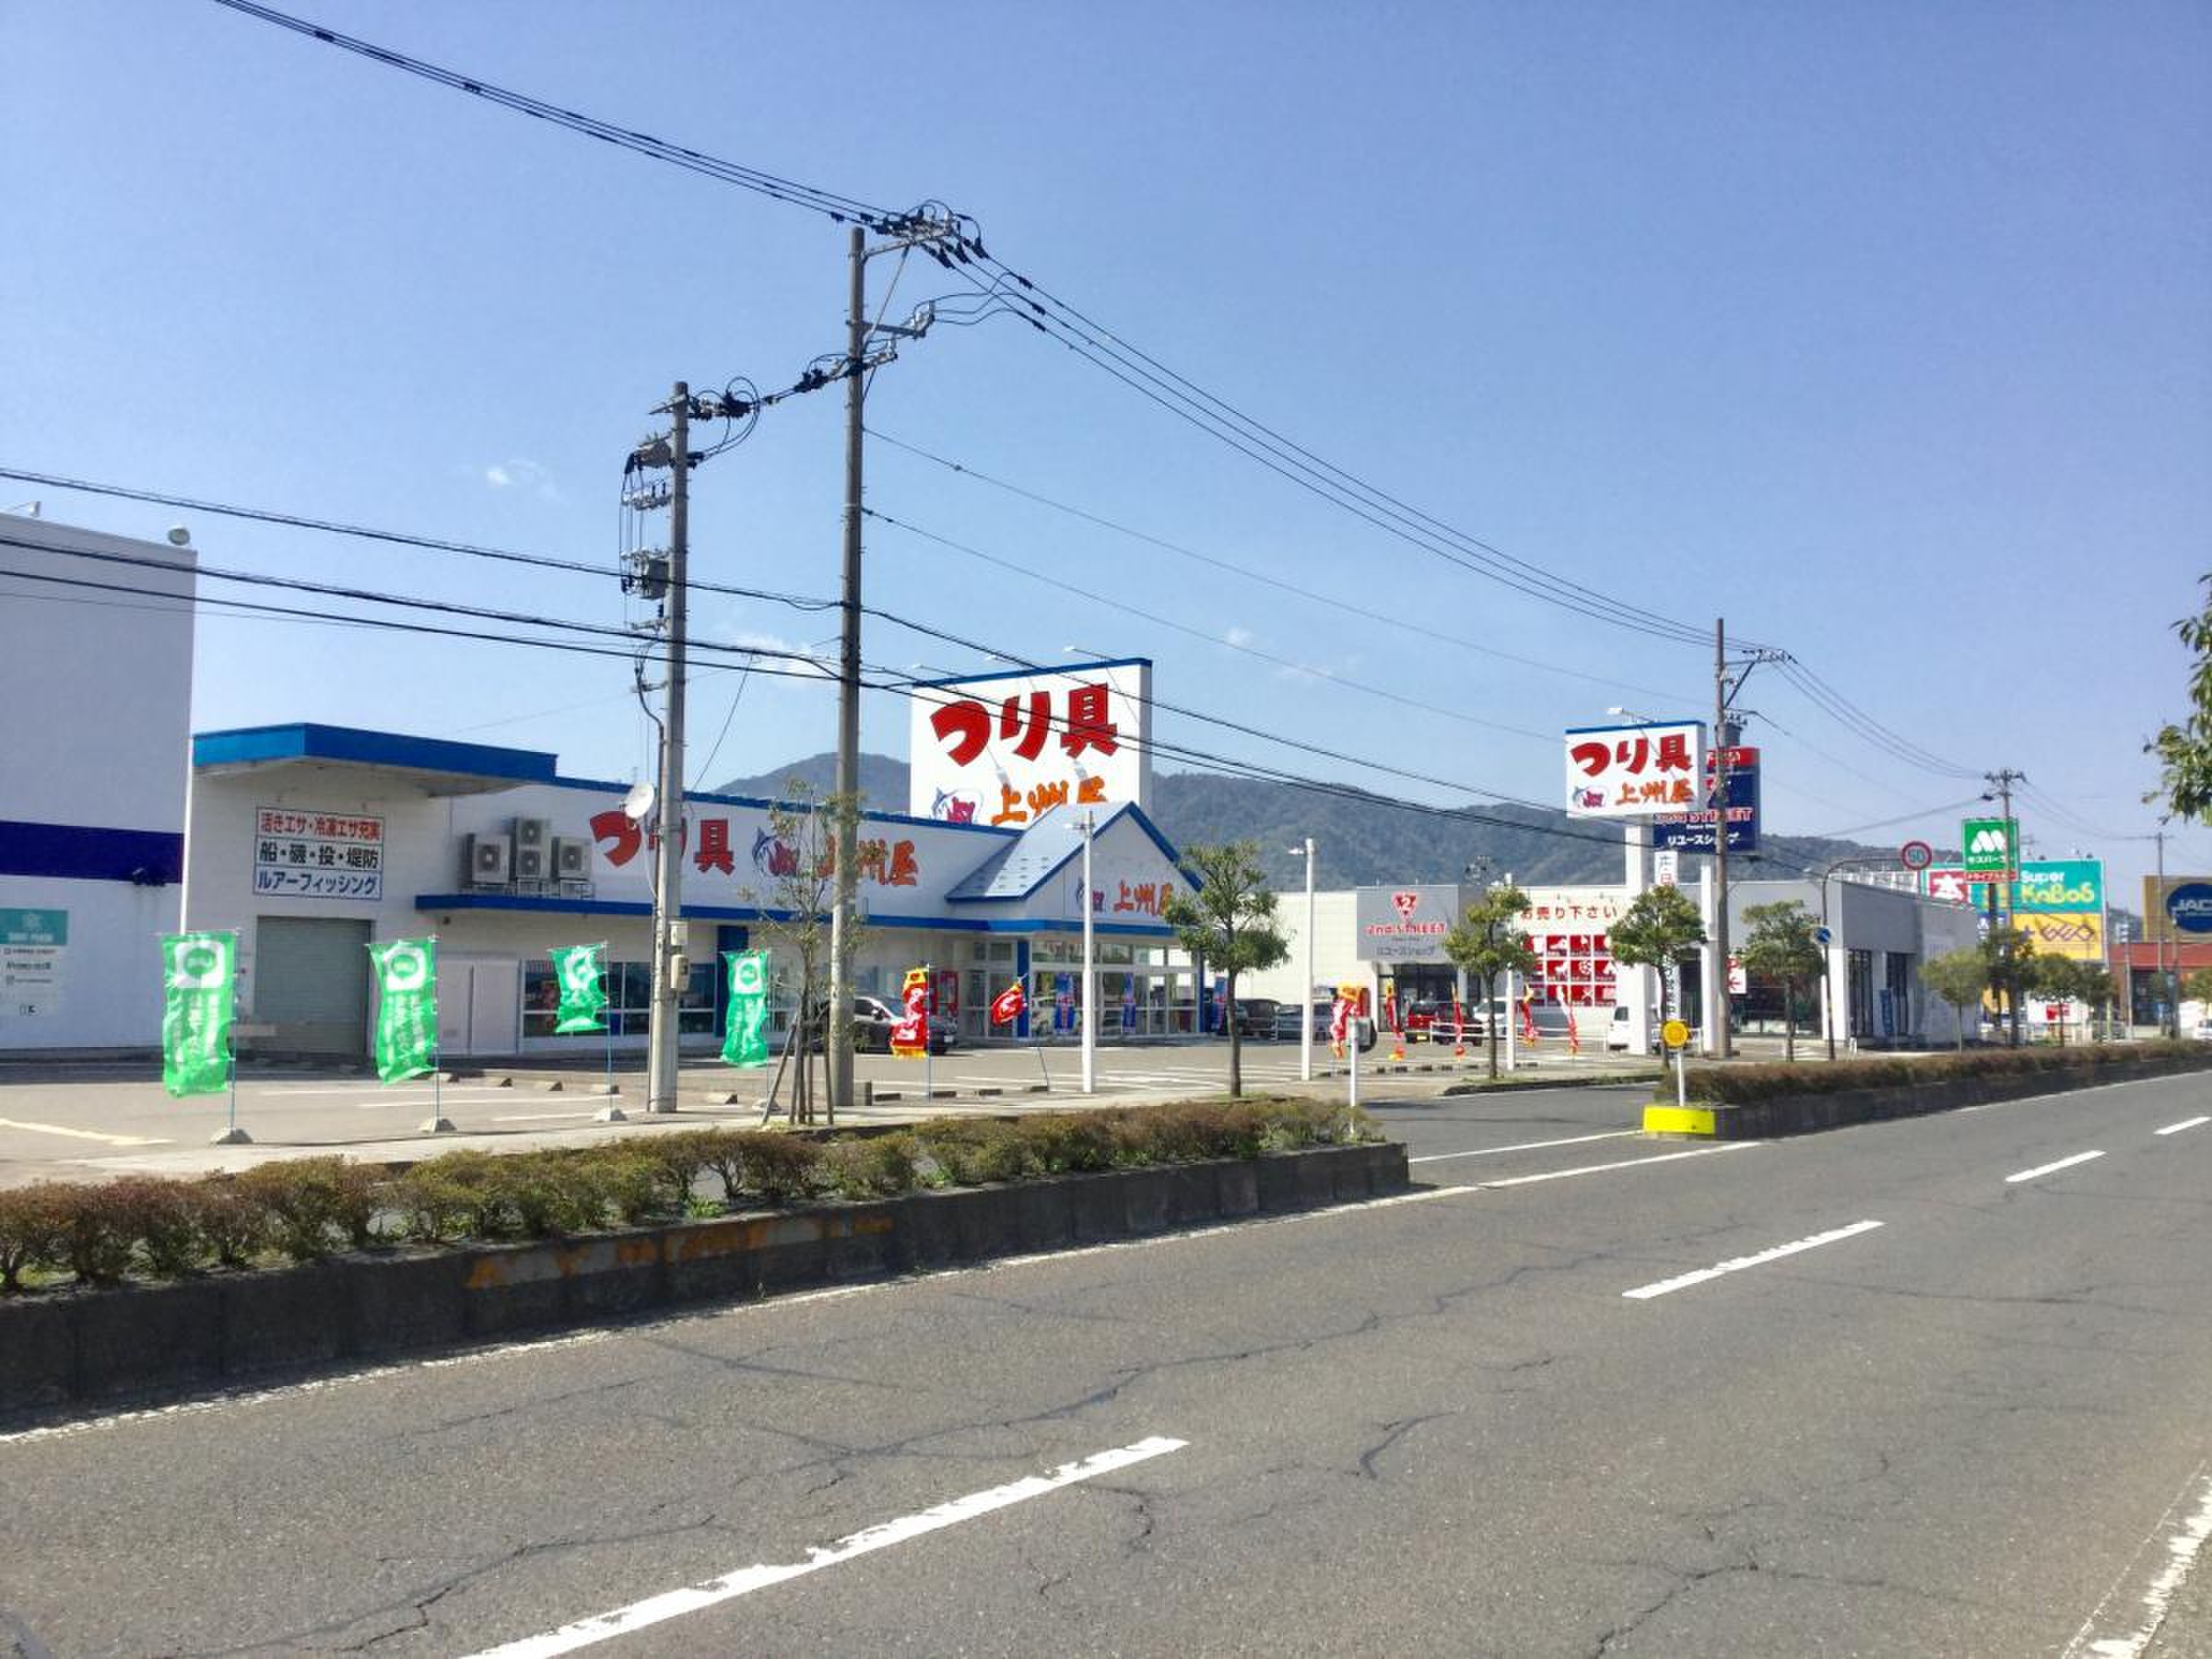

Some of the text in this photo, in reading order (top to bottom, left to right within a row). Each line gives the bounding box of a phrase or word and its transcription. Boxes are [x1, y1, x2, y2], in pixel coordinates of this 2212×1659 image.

[929, 682, 1121, 768] つり具
[1570, 734, 1693, 777] つり具
[1615, 778, 1694, 806] 上州屋
[259, 841, 379, 869] 船・磯・投・堤防
[258, 871, 378, 894] ルアーフィッシング
[2020, 869, 2065, 884] Super
[1520, 905, 1618, 920] お売り下さい
